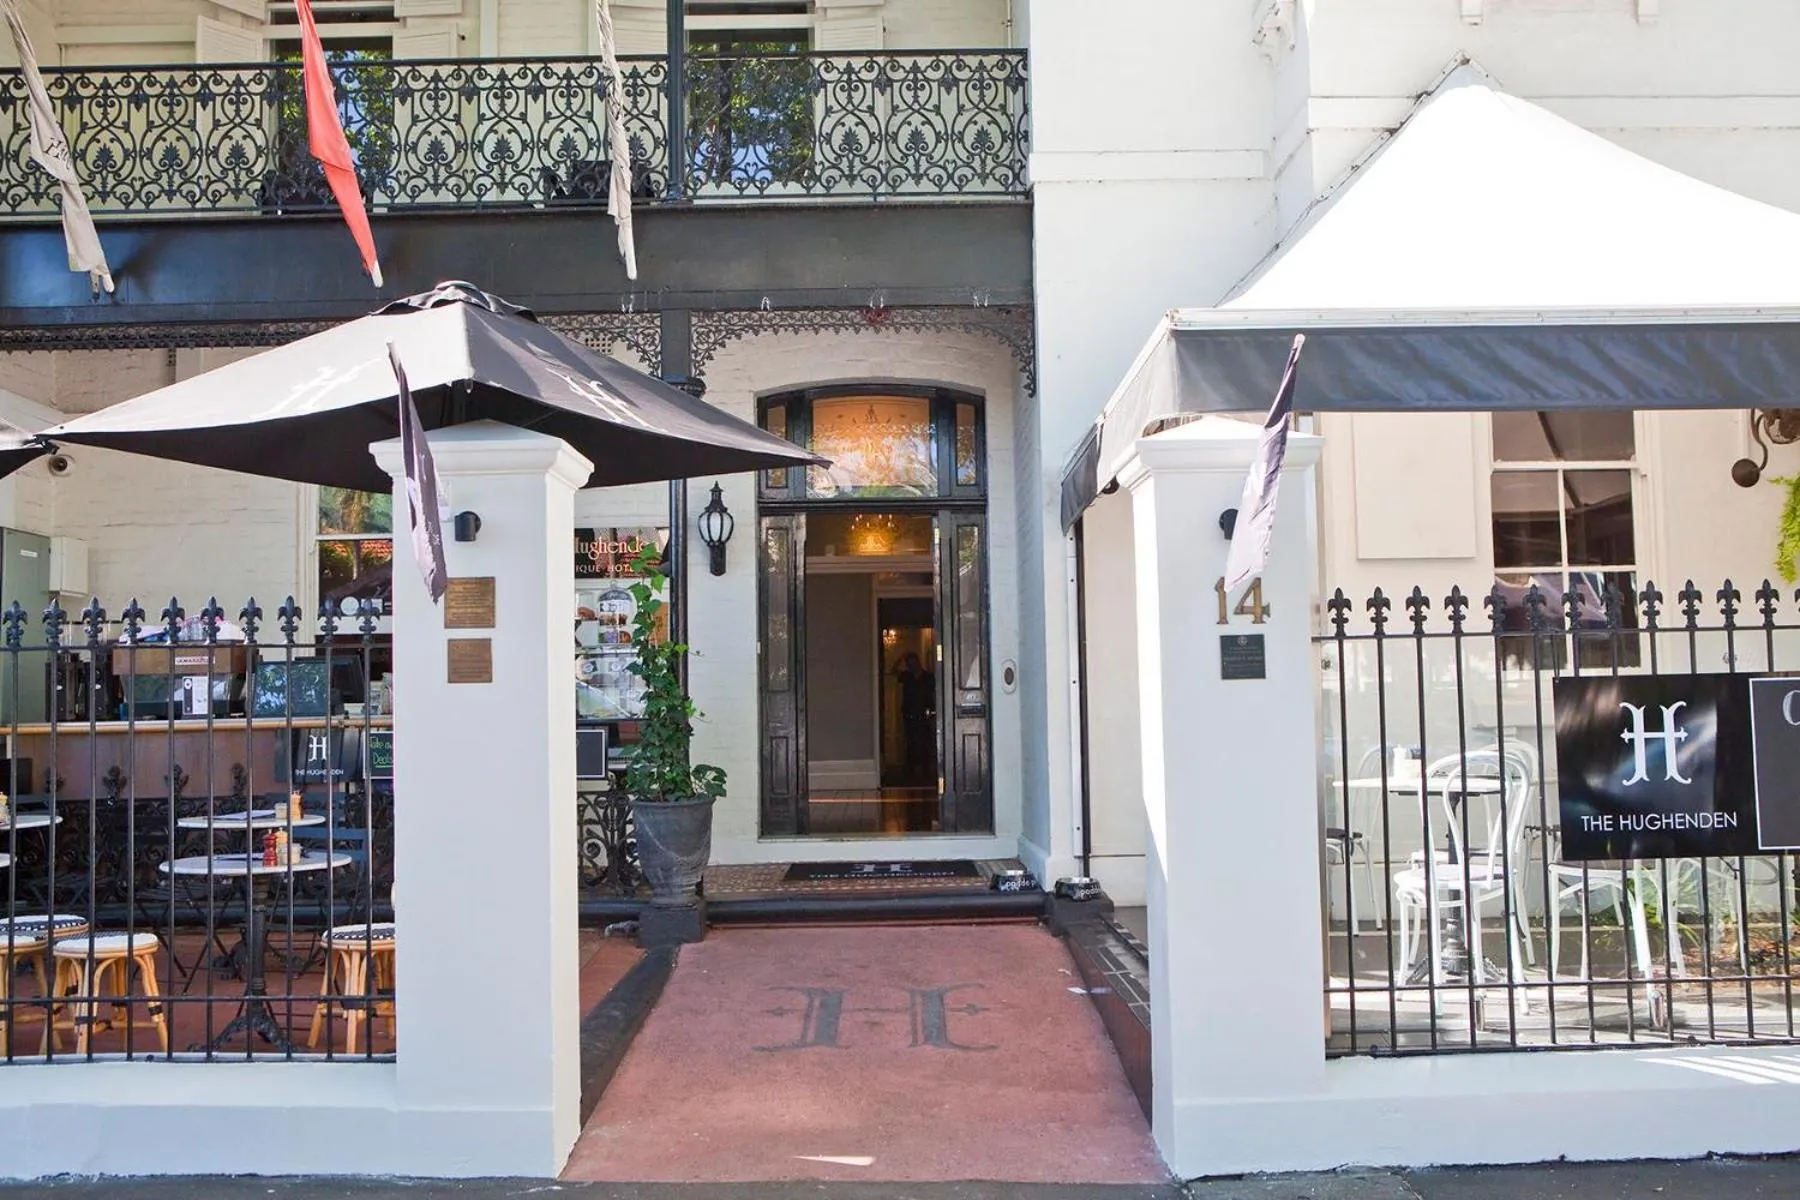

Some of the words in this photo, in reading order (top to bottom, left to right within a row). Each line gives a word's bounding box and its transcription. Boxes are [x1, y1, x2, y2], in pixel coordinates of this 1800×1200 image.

[1214, 576, 1271, 624] 14
[308, 735, 327, 761] H
[1619, 701, 1692, 786] H
[1581, 815, 1613, 831] THE
[1619, 812, 1738, 830] HUGHENDEN
